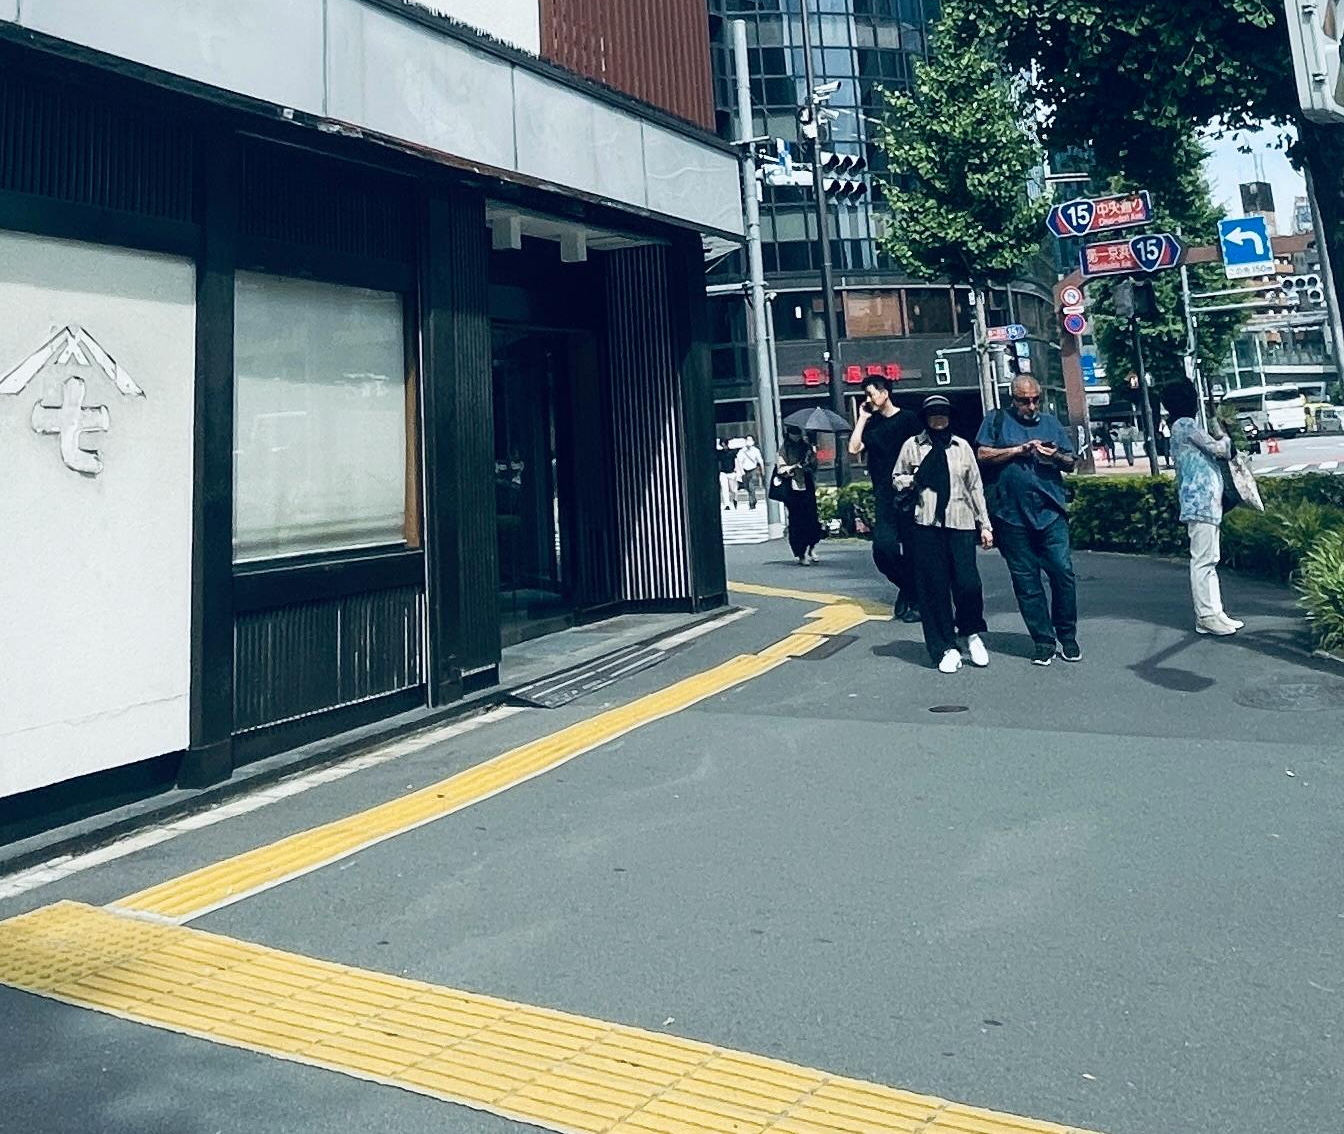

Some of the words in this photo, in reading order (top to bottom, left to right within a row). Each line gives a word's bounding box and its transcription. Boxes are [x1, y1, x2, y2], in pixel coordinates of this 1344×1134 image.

[1067, 204, 1090, 226] 15
[1097, 198, 1144, 217] 中央通り
[1136, 239, 1159, 262] 15
